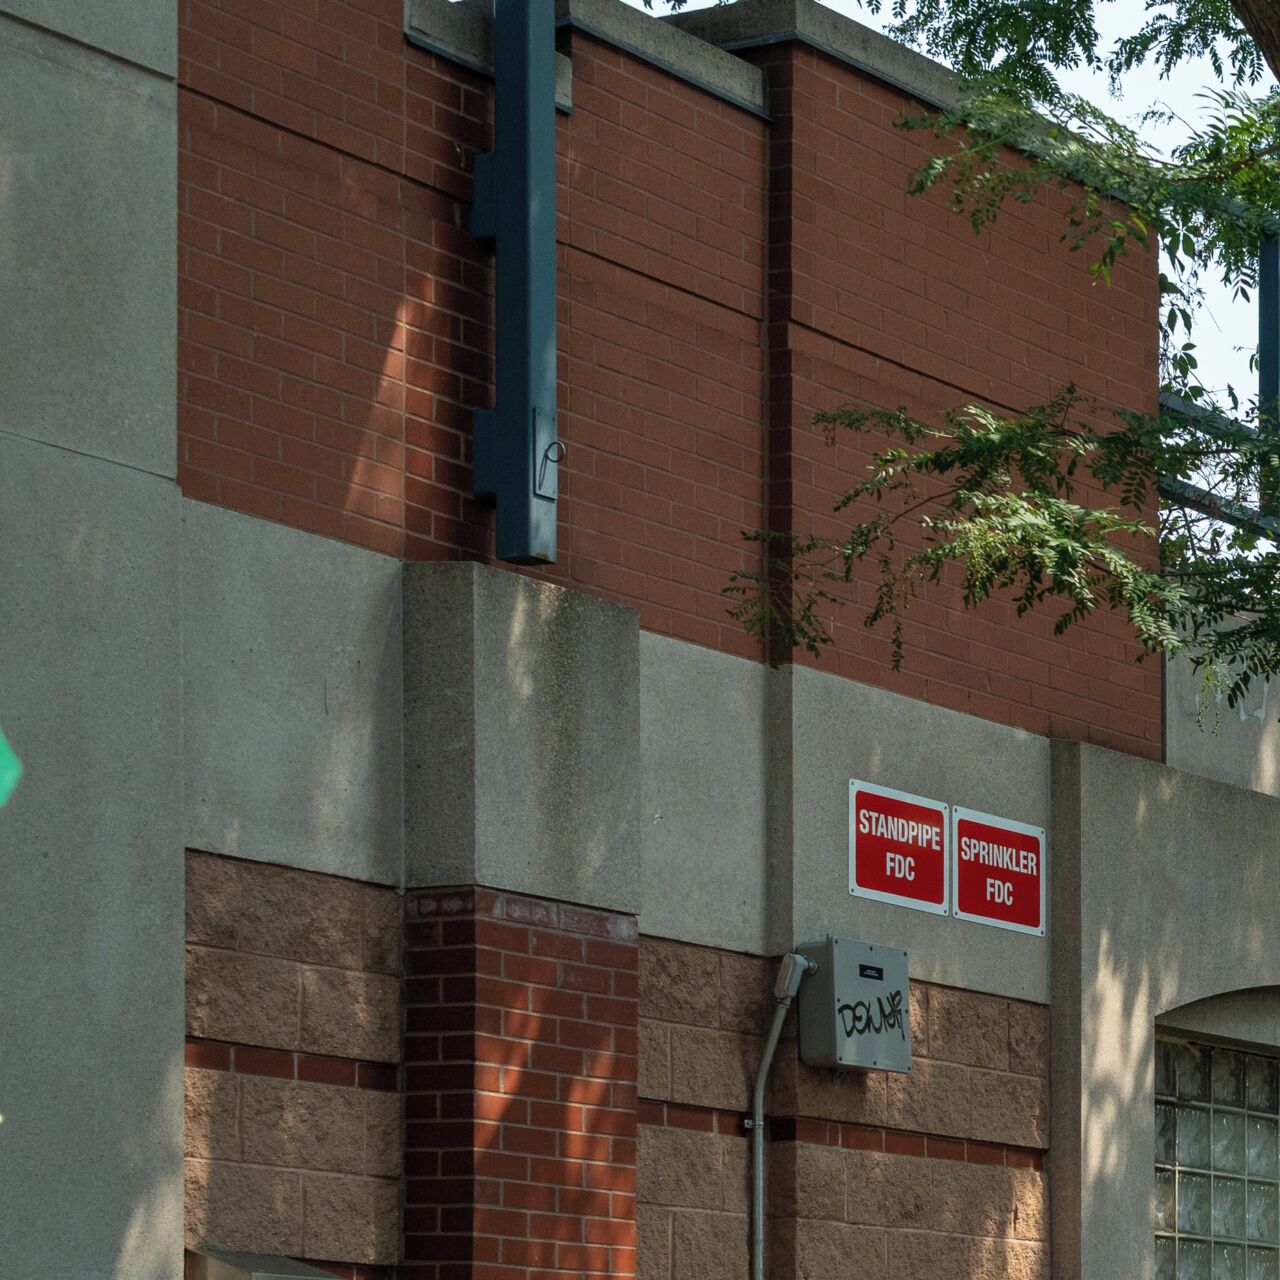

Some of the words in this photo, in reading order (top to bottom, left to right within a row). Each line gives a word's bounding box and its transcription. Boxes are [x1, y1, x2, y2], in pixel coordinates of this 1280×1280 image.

[859, 808, 941, 851] STANDPIPE
[886, 851, 915, 881] FDC
[961, 836, 1037, 876] SPRINKLER
[986, 877, 1013, 905] FDC
